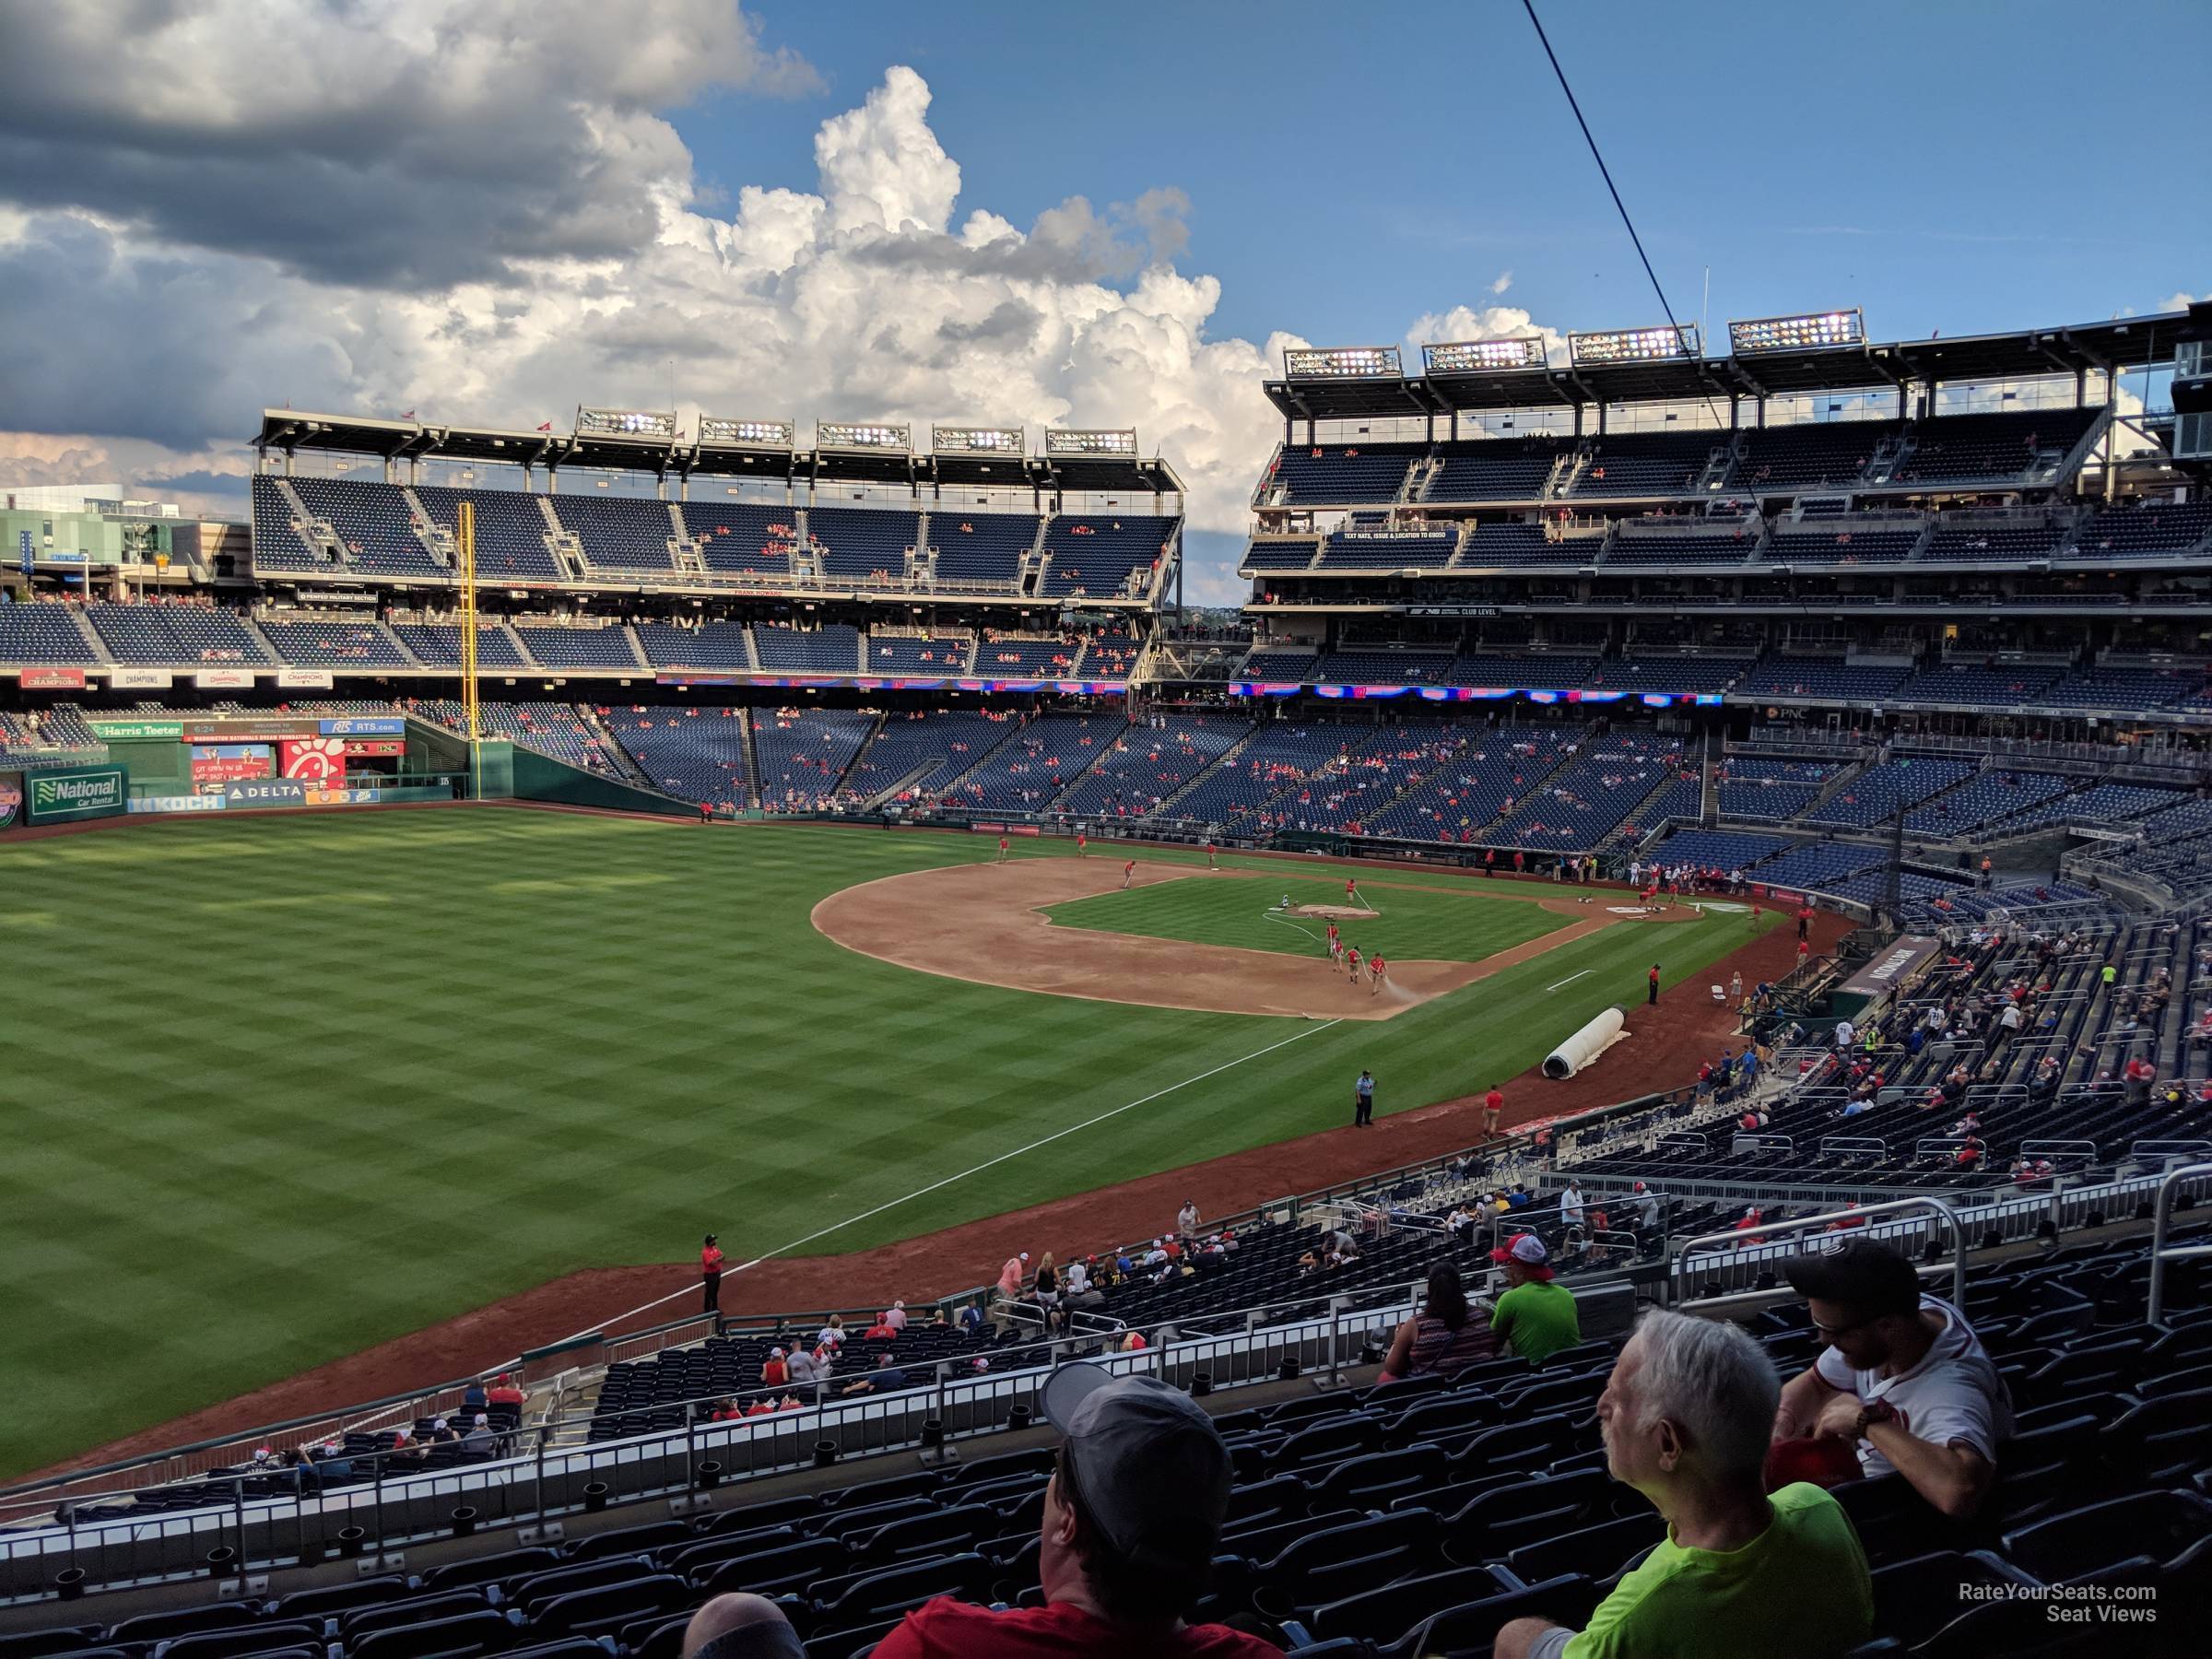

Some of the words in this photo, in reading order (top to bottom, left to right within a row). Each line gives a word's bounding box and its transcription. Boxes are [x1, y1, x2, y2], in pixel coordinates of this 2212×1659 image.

[125, 676, 158, 684] CHAMPIONS
[1781, 708, 1807, 719] PNC
[105, 726, 141, 735] Harris
[144, 725, 180, 735] Teeter
[357, 723, 395, 732] RTS.com
[248, 786, 301, 798] DELTA
[77, 799, 90, 807] Car
[91, 796, 113, 805] Rental
[155, 795, 218, 811] KOCH
